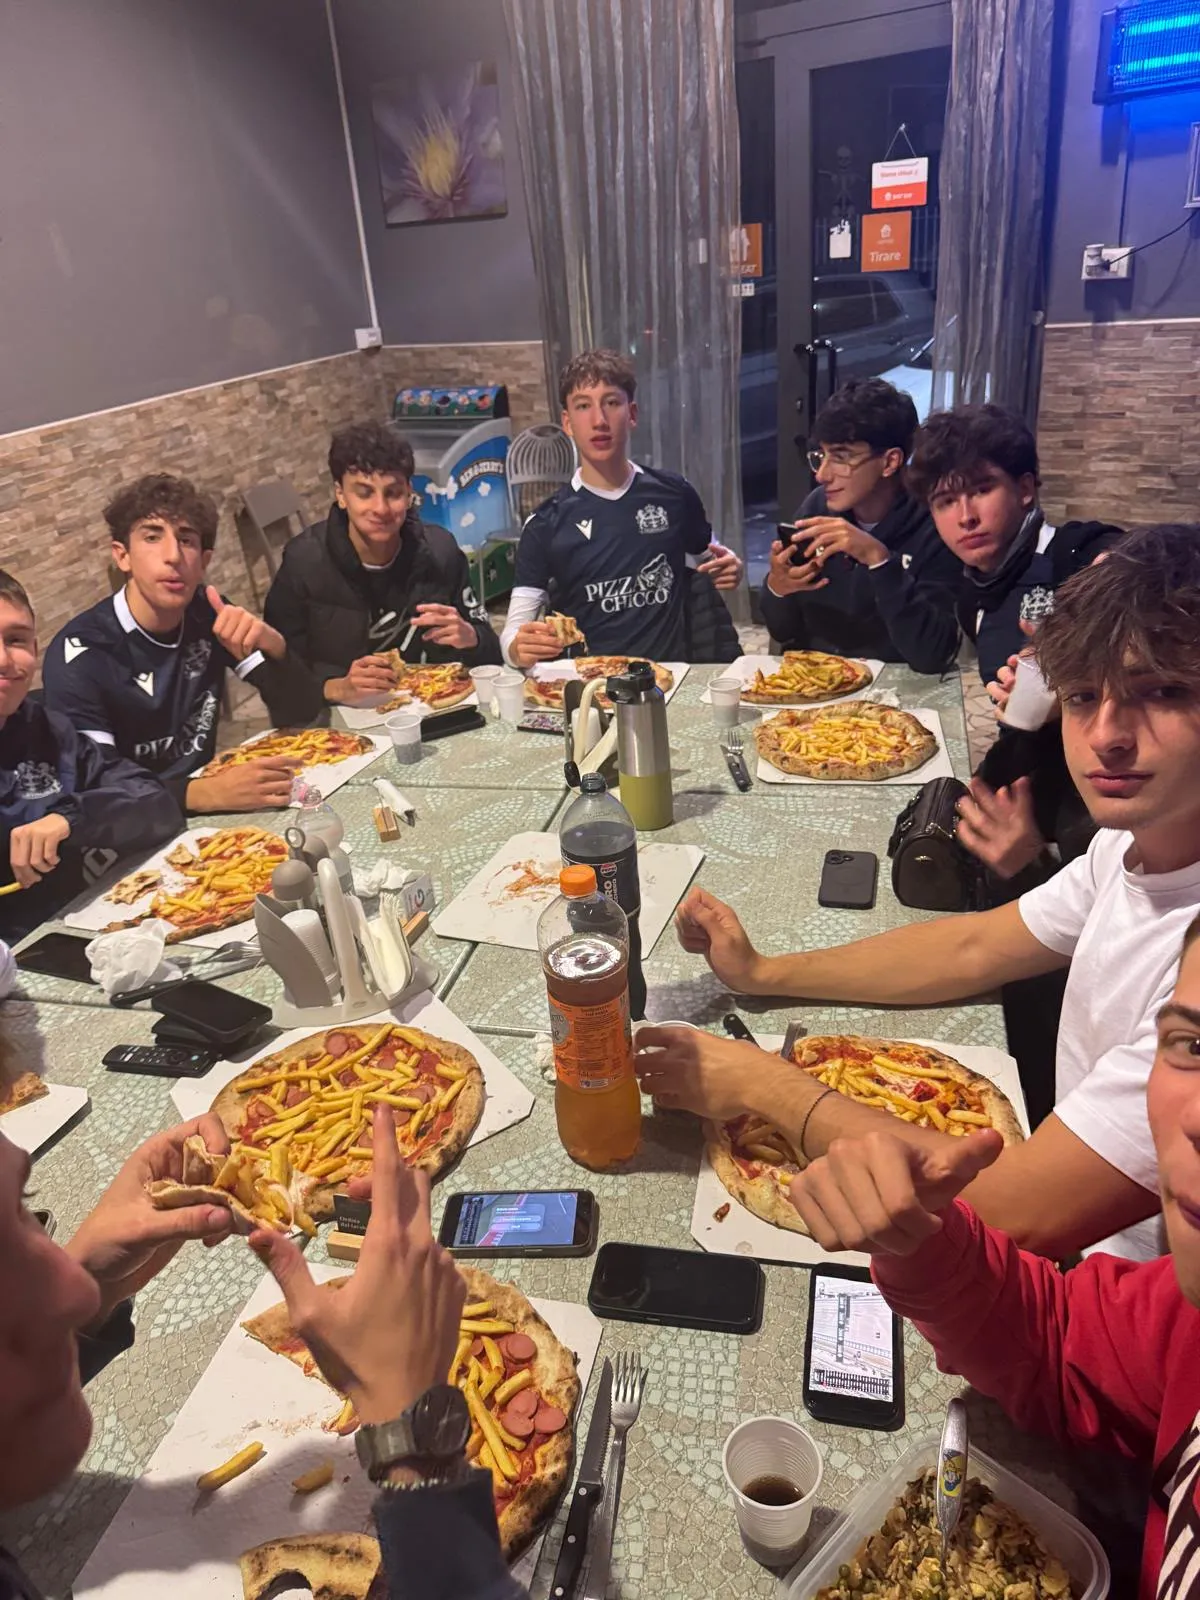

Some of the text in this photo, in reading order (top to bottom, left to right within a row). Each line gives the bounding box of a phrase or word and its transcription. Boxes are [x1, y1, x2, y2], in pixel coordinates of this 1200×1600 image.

[869, 251, 901, 262] Tirare
[584, 576, 646, 602] PIZZA
[601, 587, 669, 613] CHICCO
